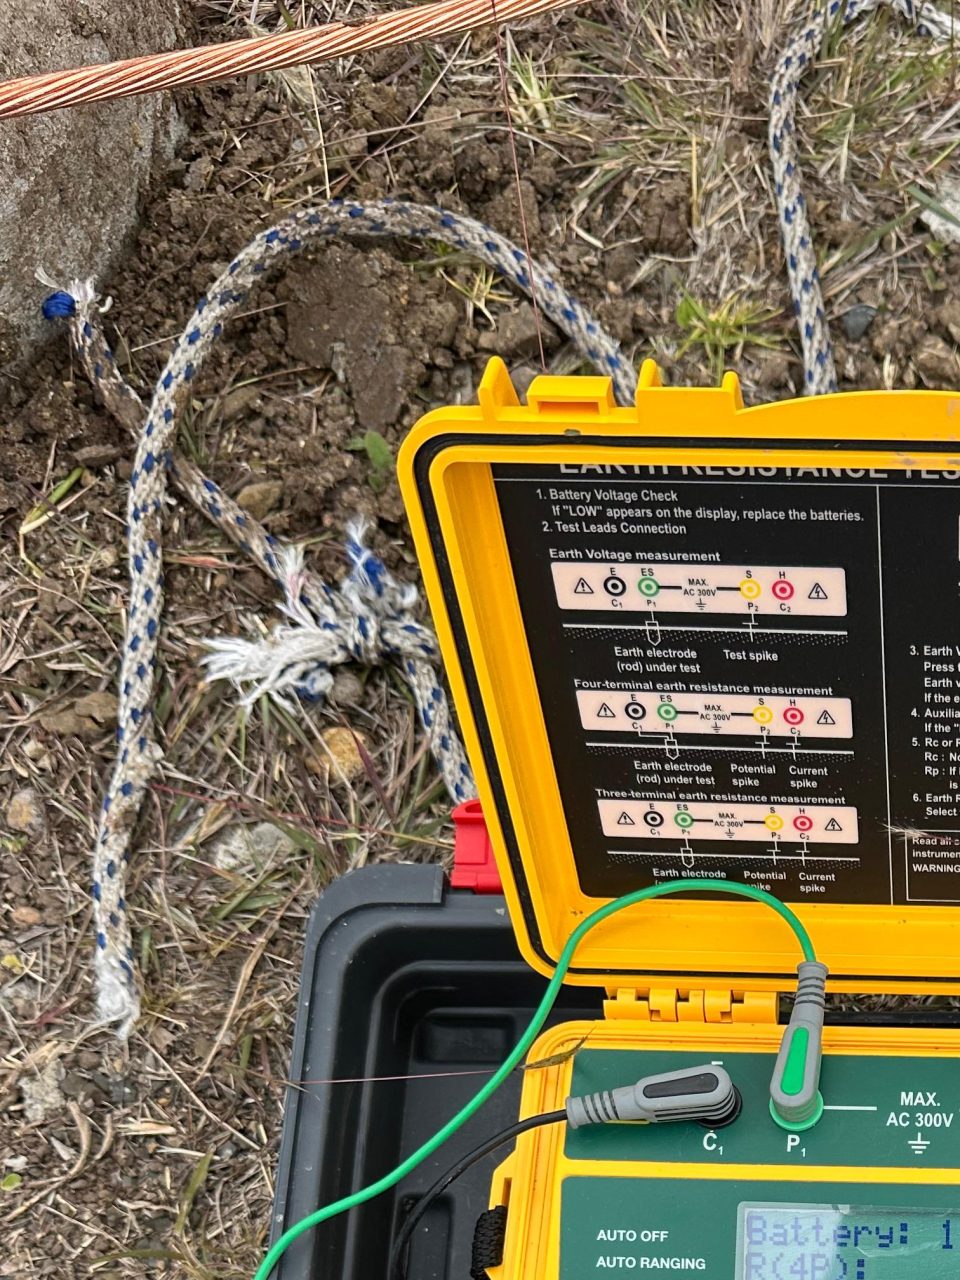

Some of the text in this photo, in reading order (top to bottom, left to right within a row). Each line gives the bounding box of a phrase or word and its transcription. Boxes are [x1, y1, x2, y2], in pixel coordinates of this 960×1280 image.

[536, 488, 678, 503] 1. Battery Voltage Check
[551, 504, 560, 516] If
[606, 508, 653, 519] appears
[655, 508, 671, 518] on
[673, 506, 692, 518] the
[695, 506, 740, 521] display,
[742, 508, 785, 521] replace
[788, 508, 807, 520] the
[809, 508, 864, 521] batteries.
[541, 520, 686, 534] 2. Test Leads Connection
[549, 548, 721, 562] Earth Voltage measurement
[614, 646, 697, 659] Earth electrode
[722, 649, 778, 662] Test spike
[909, 645, 919, 655] 3.
[923, 645, 953, 656] Earth
[616, 660, 701, 673] (rod) under test
[923, 661, 955, 672] Press
[573, 678, 833, 696] Four-terminal earth resistance measurement
[924, 677, 952, 688] Earth
[924, 692, 931, 703] If
[933, 692, 951, 703] the
[910, 707, 920, 717] 4.
[911, 737, 920, 747] 5.
[924, 737, 939, 747] Rc
[941, 739, 953, 747] or
[633, 760, 712, 772] Earth electrode
[730, 763, 776, 774] Potential
[788, 765, 828, 776] Current
[636, 773, 715, 785] (rod) under test
[731, 776, 759, 788] spike
[790, 778, 817, 789] spike
[594, 788, 846, 804] Three-terminal earth resistance measurement
[912, 792, 921, 802] 6.
[925, 793, 953, 802] Earth
[652, 867, 726, 878] Earth electrode
[743, 870, 786, 880] Potential
[798, 872, 835, 881] Current
[799, 883, 825, 893] spike
[900, 1091, 940, 1106] MAX.
[886, 1111, 954, 1127] AC 300V
[596, 1229, 669, 1242] AUTO OFF
[746, 1215, 908, 1248] Battery:
[595, 1255, 706, 1270] AUTO RANGING
